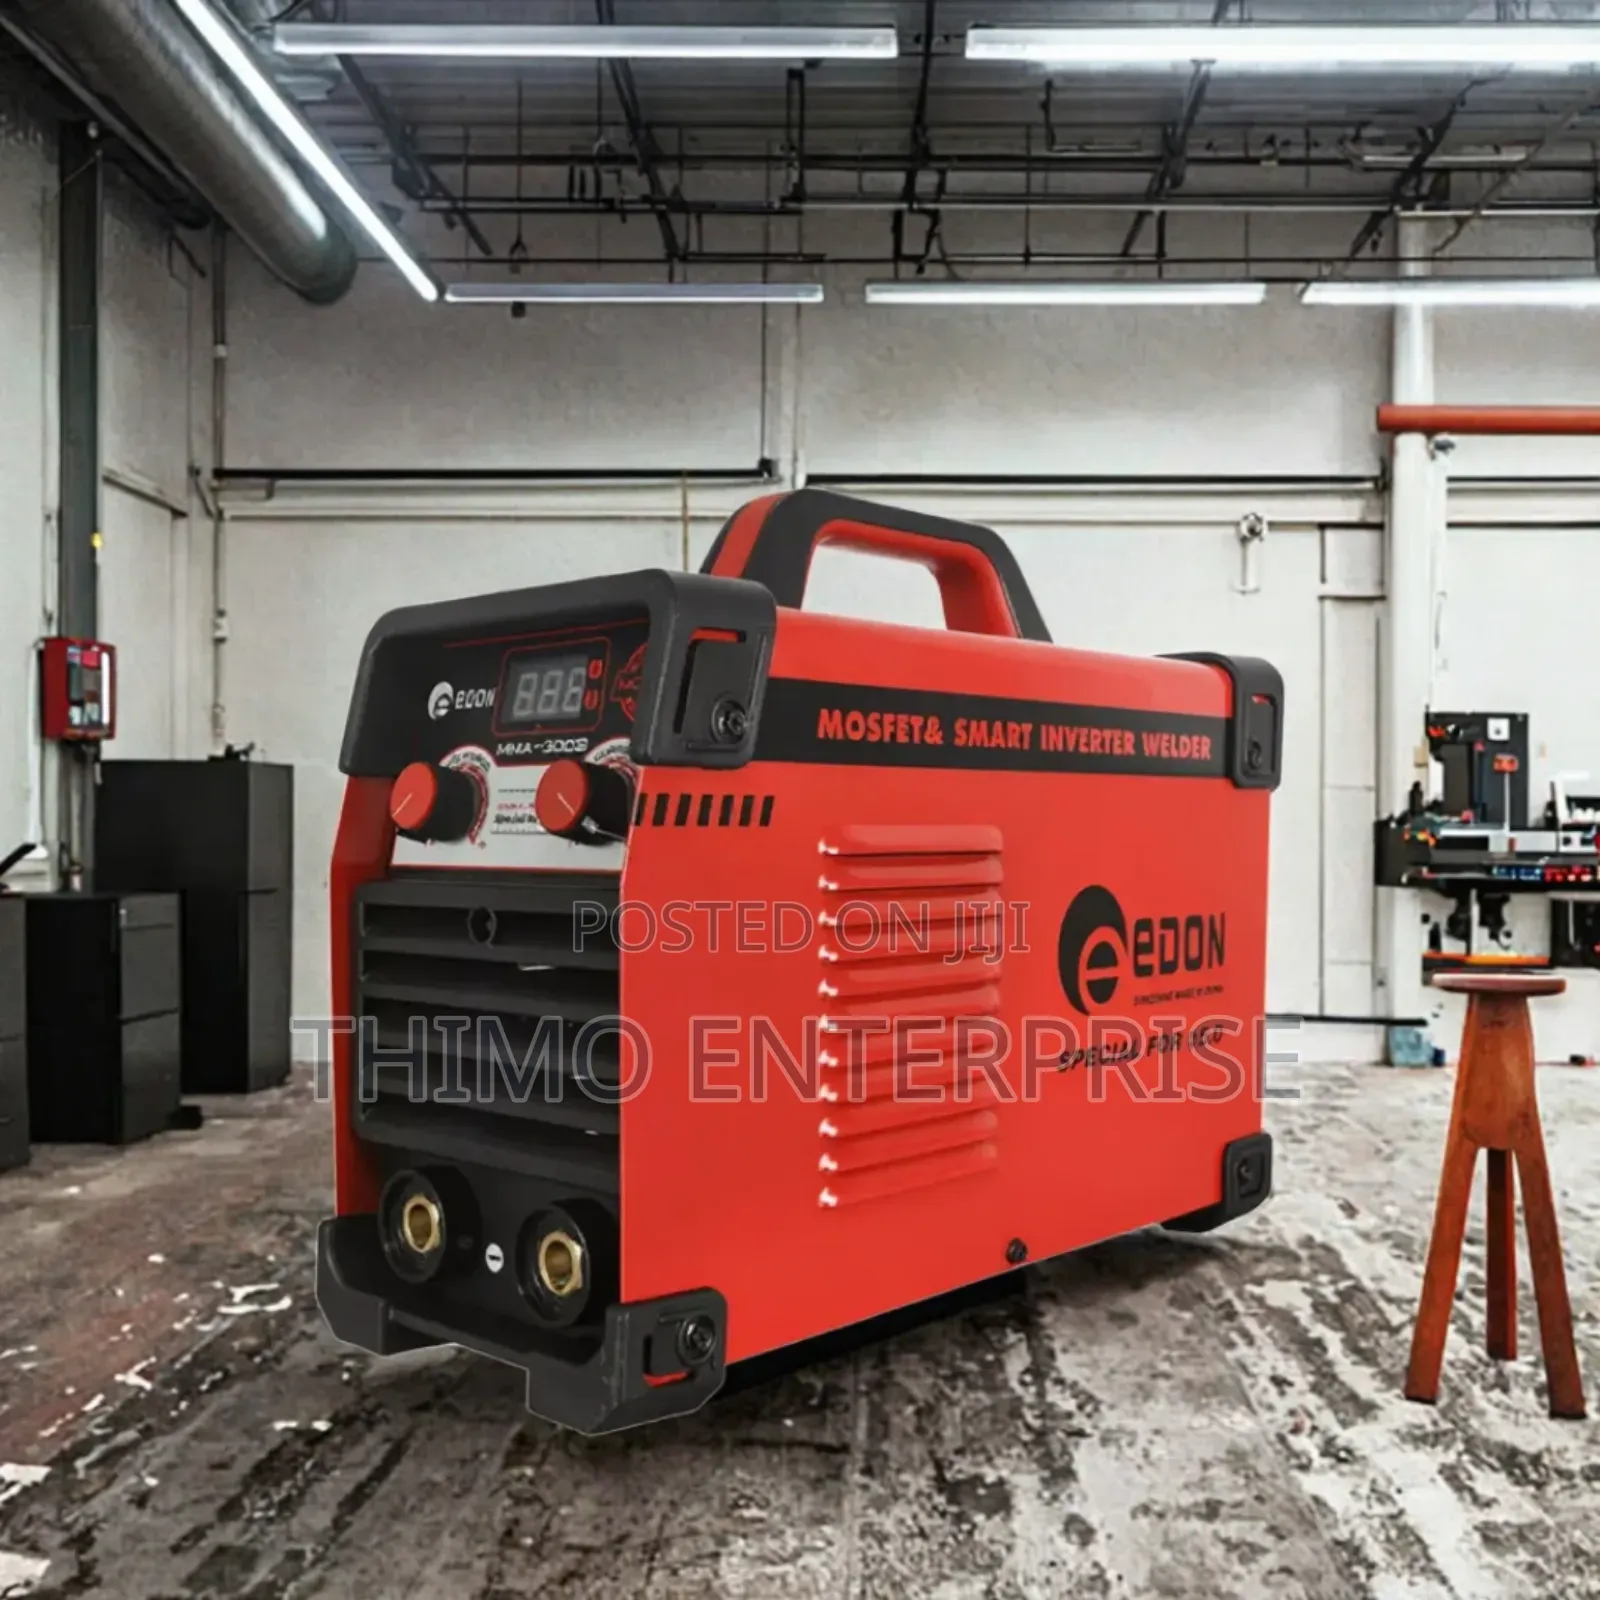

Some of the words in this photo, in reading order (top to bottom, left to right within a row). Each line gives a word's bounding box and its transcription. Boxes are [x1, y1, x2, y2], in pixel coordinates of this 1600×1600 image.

[817, 708, 943, 745] MOSFET&
[954, 718, 1033, 750] SMART
[1040, 724, 1135, 756] INVERTER
[1142, 732, 1211, 760] WELDER
[1057, 1037, 1141, 1073] SPECIAL
[1147, 1031, 1183, 1058] FOR
